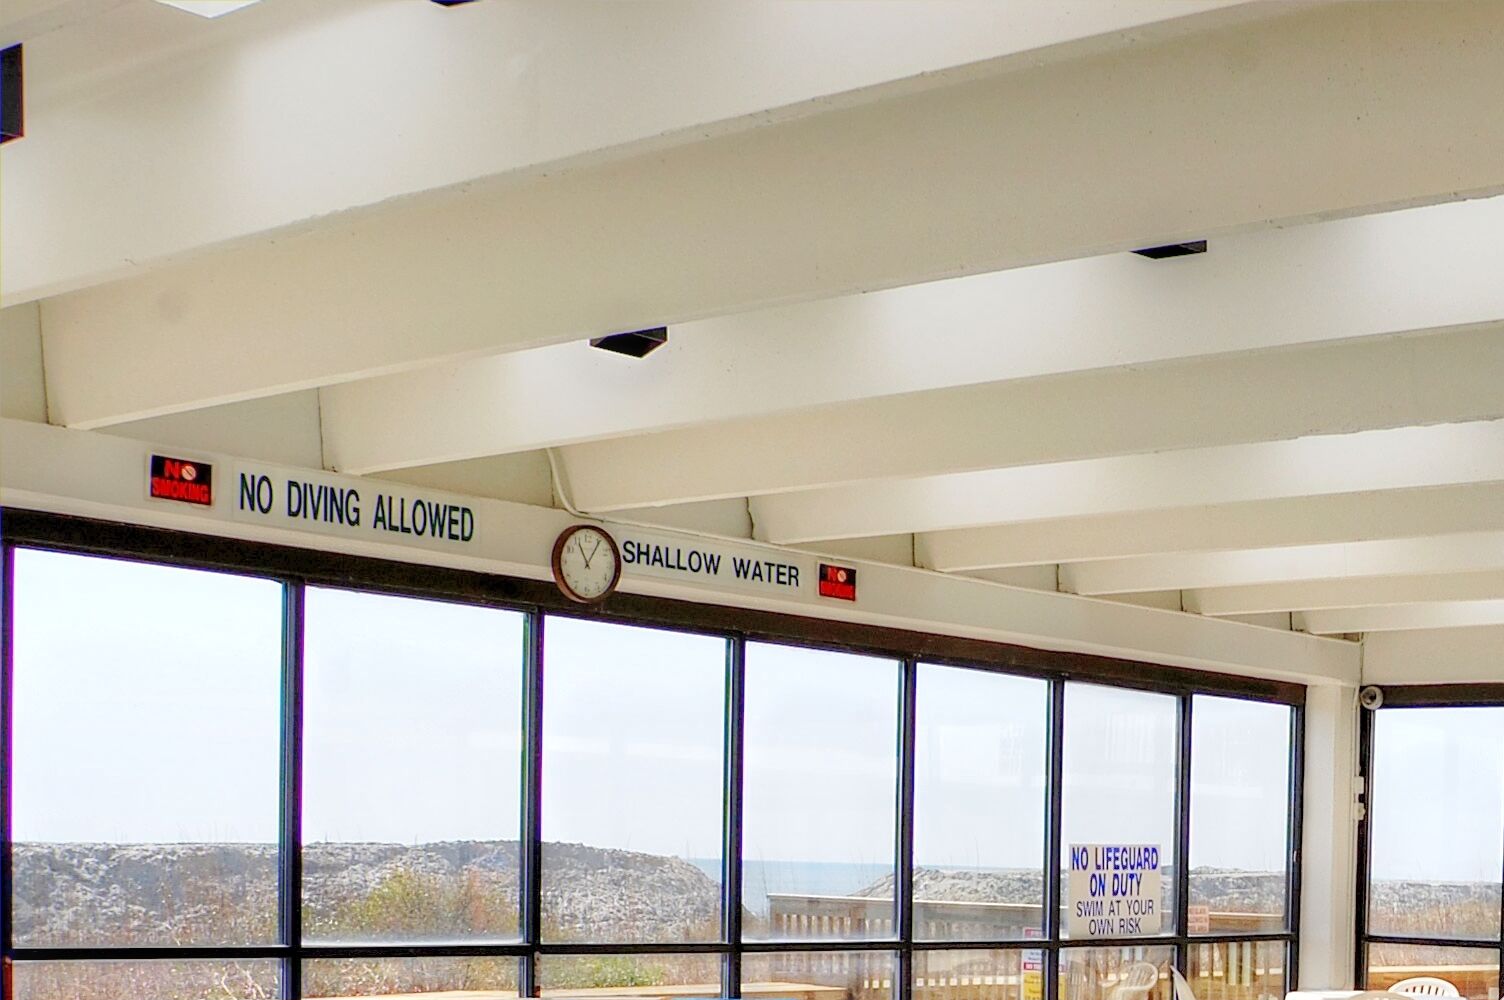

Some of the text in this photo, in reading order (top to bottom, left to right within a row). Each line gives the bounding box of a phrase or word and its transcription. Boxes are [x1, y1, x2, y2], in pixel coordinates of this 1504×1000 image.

[164, 460, 197, 481] NO
[152, 477, 209, 502] SMOKING
[239, 472, 474, 542] NO DIVING ALLOWED
[622, 540, 799, 587] SHALLOW WATER
[1072, 847, 1159, 870] NO LIFEGUARD
[1090, 873, 1143, 897] ON DUTY
[1076, 899, 1154, 917] SWIM AT YOUR
[1089, 918, 1141, 935] OWN RISK
